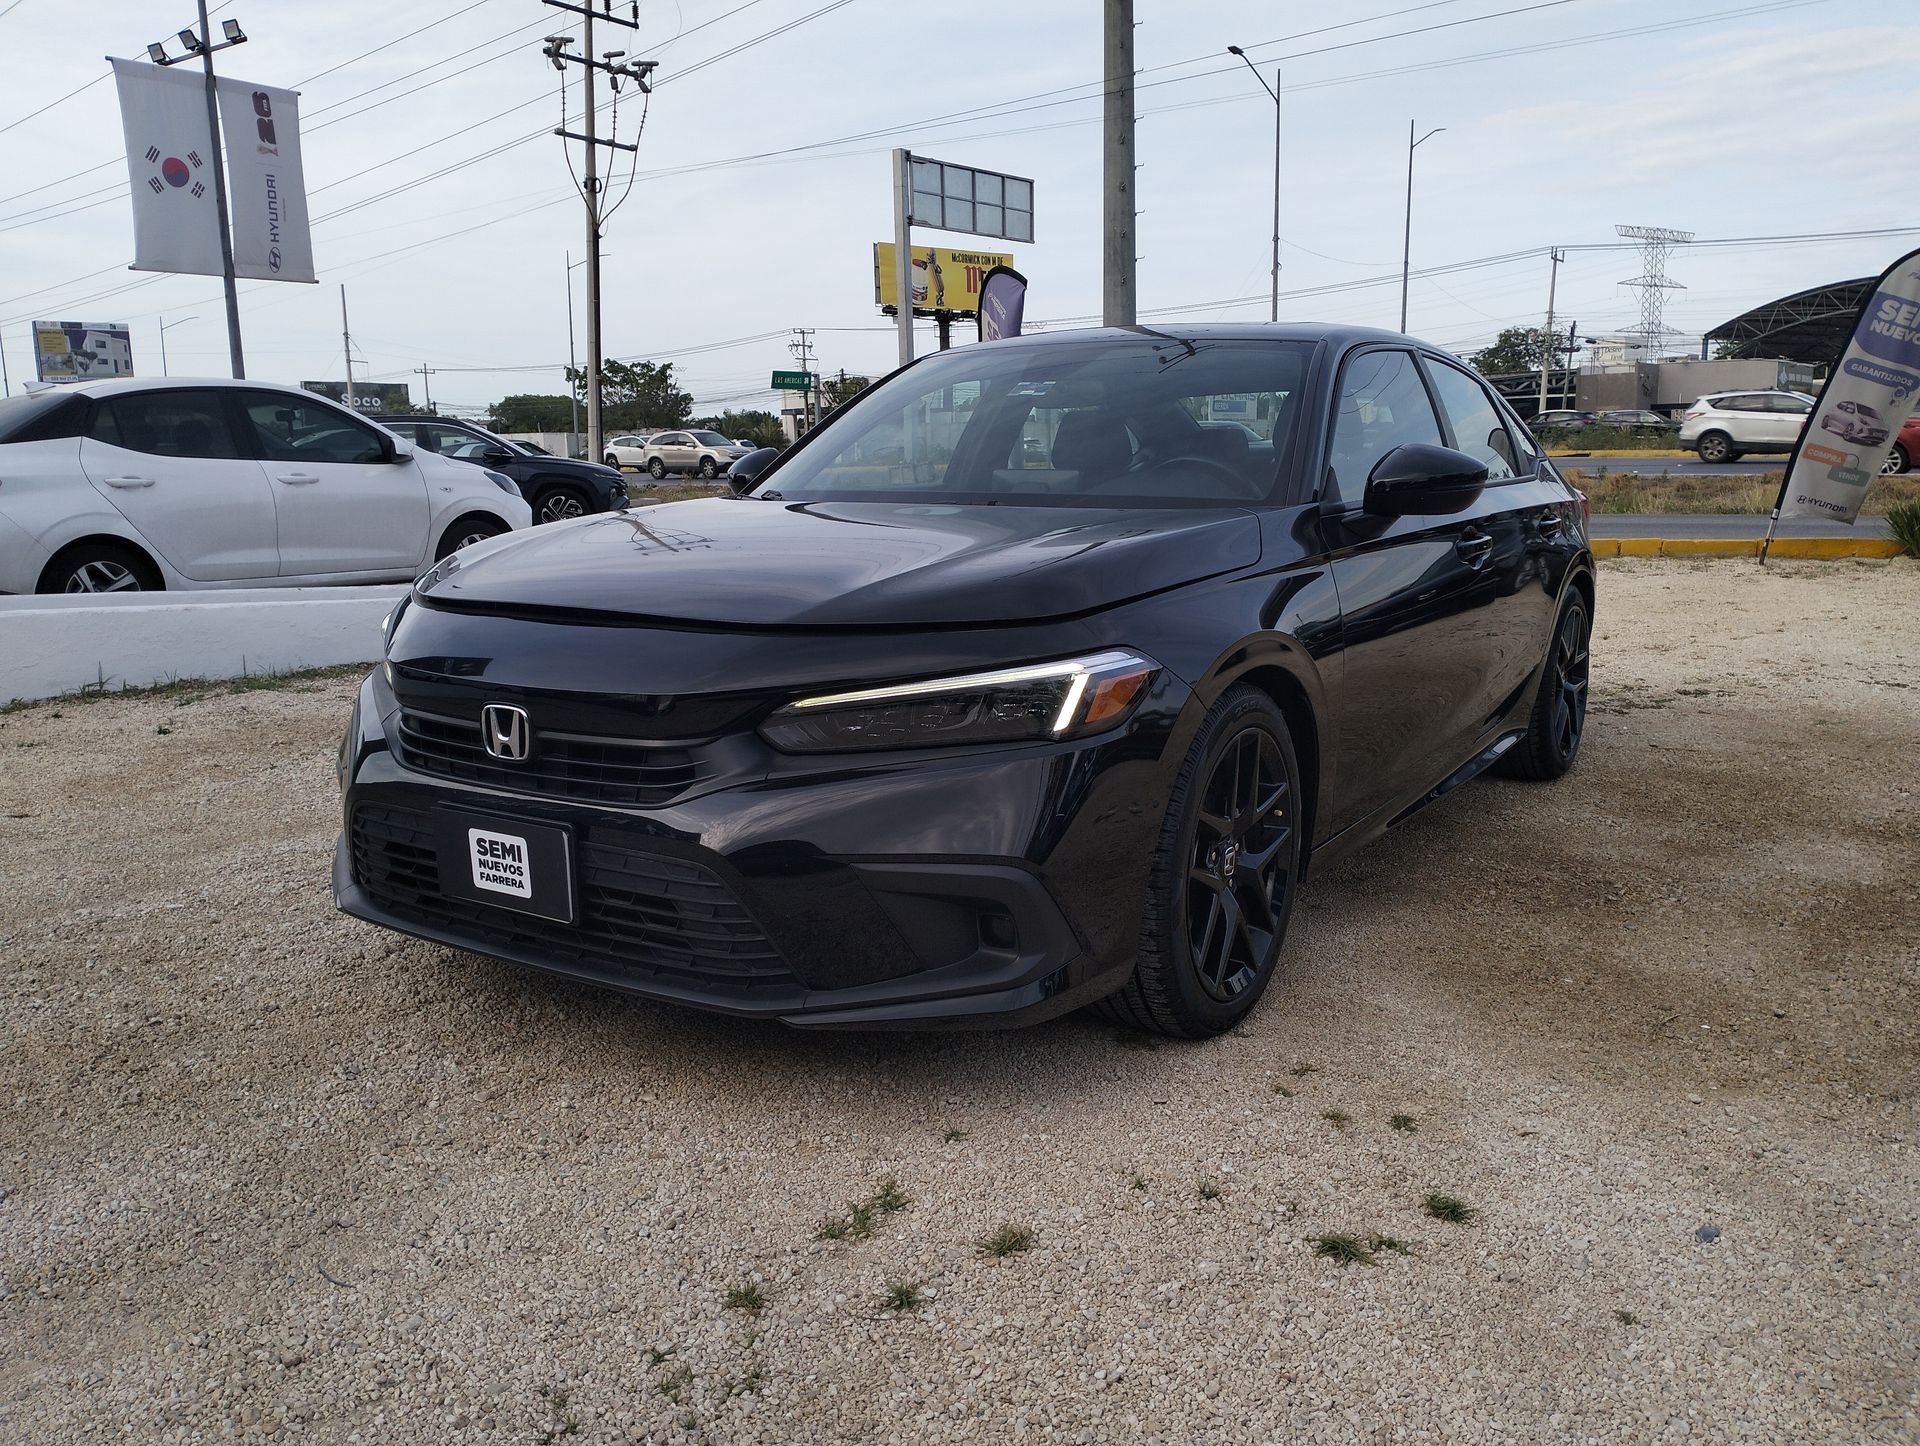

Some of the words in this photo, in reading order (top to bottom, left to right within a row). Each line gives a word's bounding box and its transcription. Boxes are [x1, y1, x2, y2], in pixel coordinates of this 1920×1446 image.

[265, 173, 280, 243] HYUNDAI
[981, 256, 991, 266] CON
[1877, 299, 1920, 329] SE
[1851, 363, 1914, 387] GARANTIZADOS
[1807, 448, 1841, 464] COMPRA
[1838, 471, 1860, 481] VENDE
[1808, 497, 1847, 513] HYUNDAI
[476, 838, 523, 863] SEMI
[478, 858, 524, 877] NUEVOS
[479, 871, 525, 889] FARRERA
